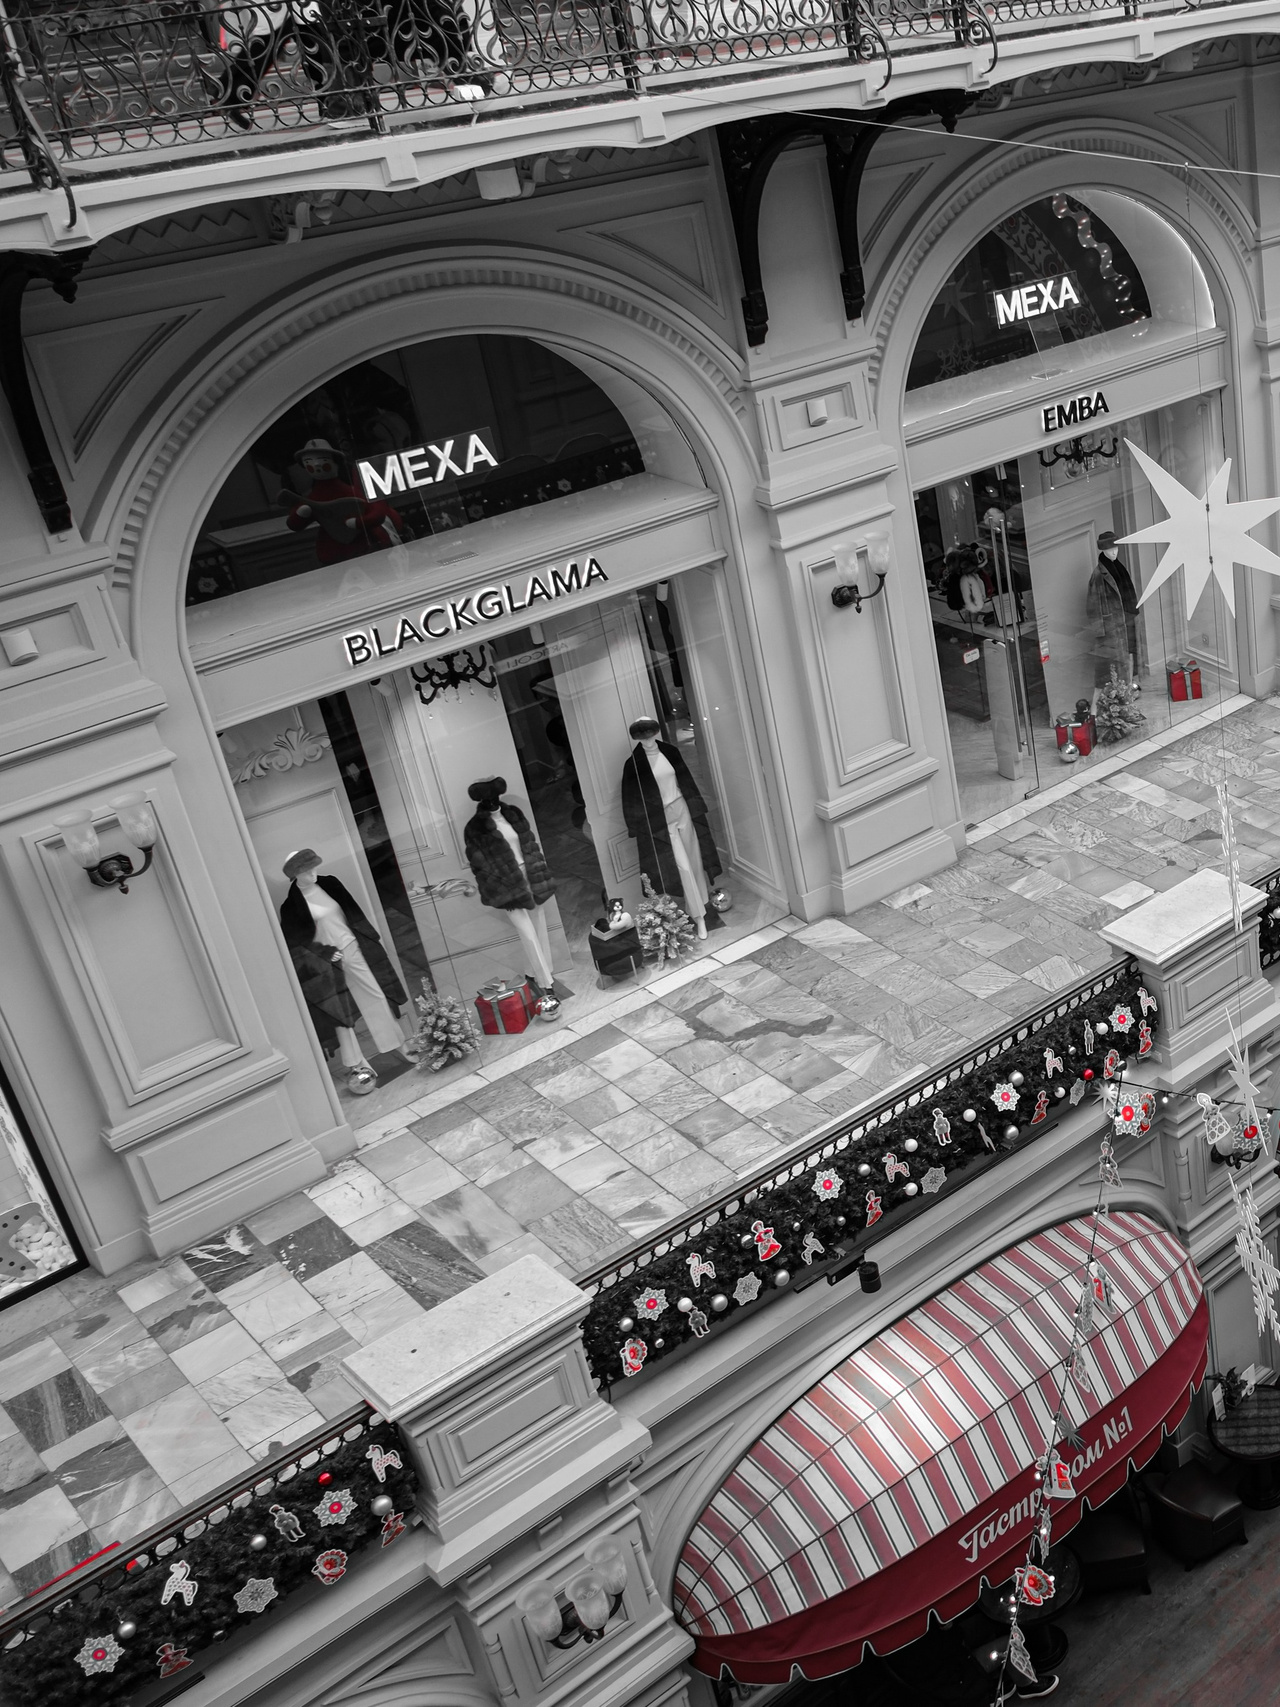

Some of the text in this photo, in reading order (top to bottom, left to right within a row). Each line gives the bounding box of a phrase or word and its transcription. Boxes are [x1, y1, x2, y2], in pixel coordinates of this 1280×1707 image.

[1042, 391, 1110, 433] EMBA
[344, 555, 609, 666] BLACKGLAMA
[957, 1405, 1133, 1563] Гастром №1
